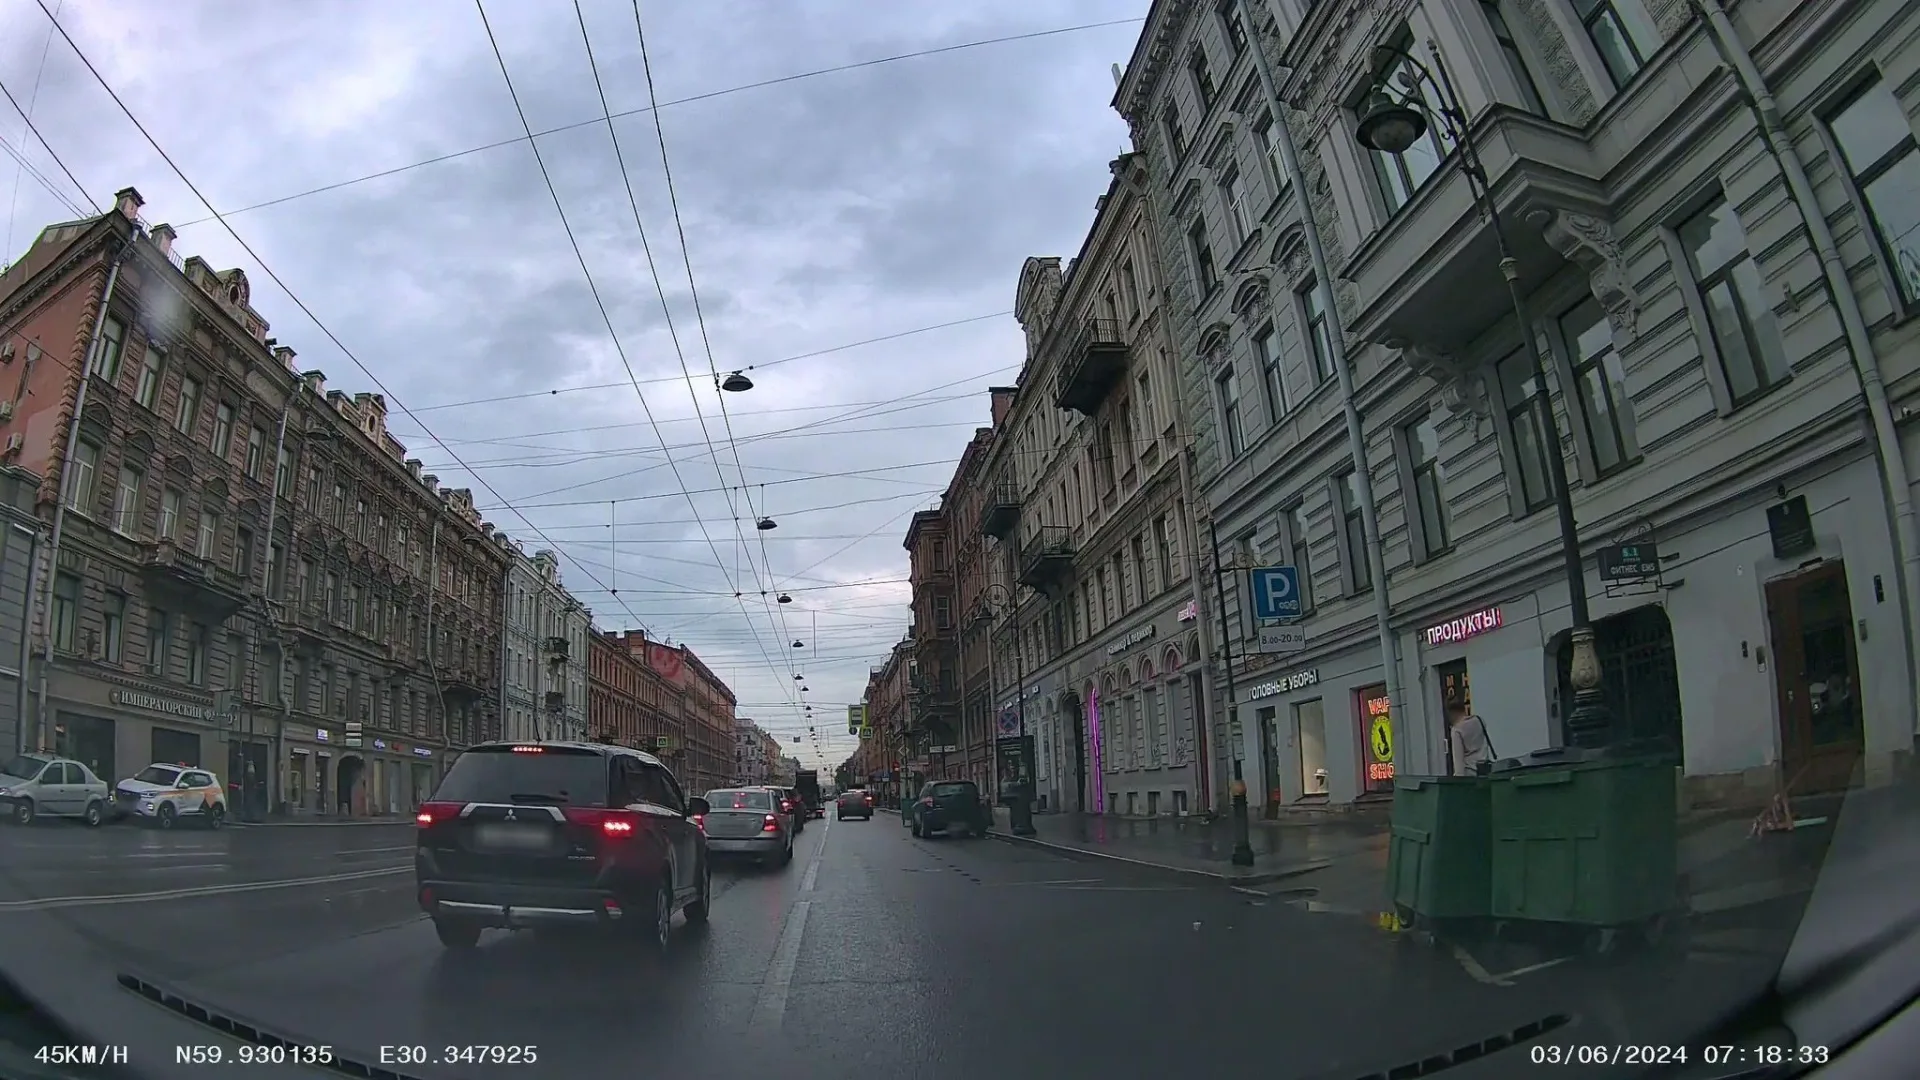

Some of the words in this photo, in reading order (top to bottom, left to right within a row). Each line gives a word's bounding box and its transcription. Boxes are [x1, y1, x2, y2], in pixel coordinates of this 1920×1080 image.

[1609, 564, 1639, 575] ФИТНЕС
[1247, 678, 1288, 701] ГОЛОВНЫЕ
[1288, 668, 1318, 690] УБОРЫ
[120, 690, 202, 719] ИМПЕРАТОРСКИЙ
